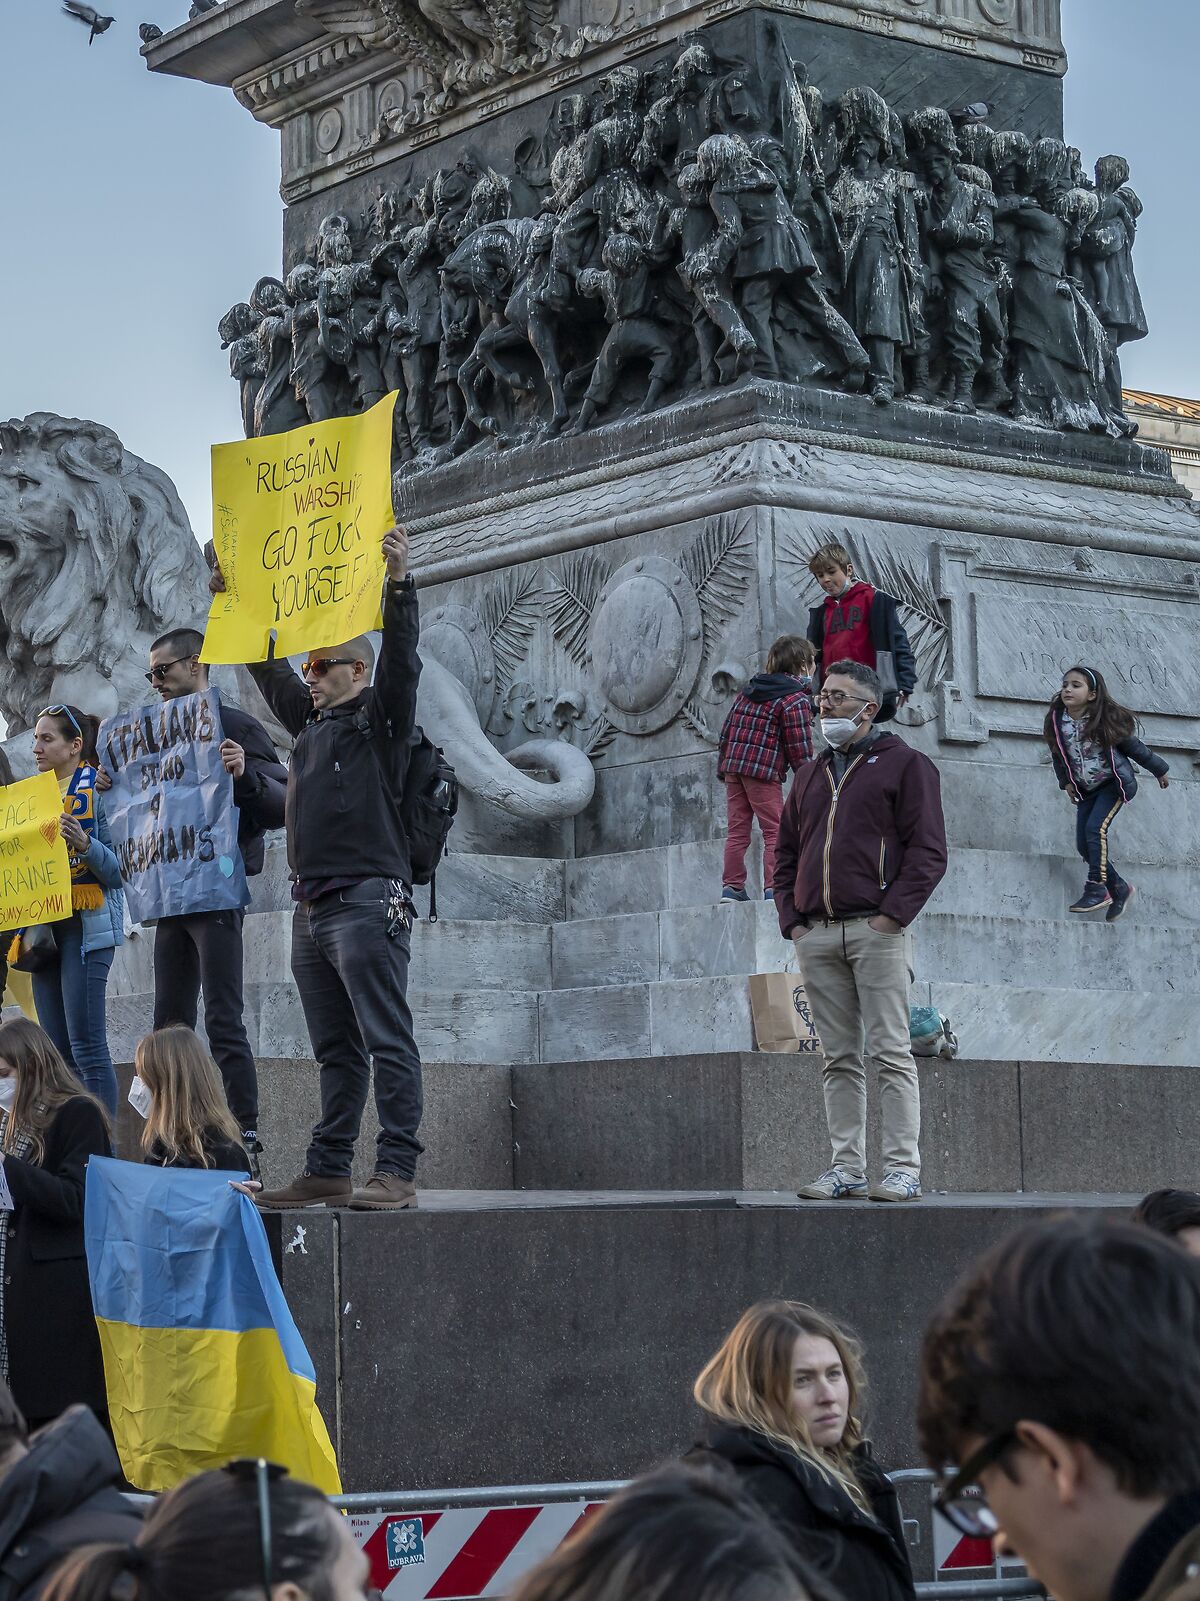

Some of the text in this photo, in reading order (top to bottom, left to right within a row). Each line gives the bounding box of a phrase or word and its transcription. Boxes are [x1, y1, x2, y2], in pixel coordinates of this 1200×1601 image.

[262, 506, 363, 570] GO FUCK
[824, 605, 863, 634] AP
[106, 699, 213, 773] ITALIANS
[0, 836, 25, 859] FOR
[799, 1038, 820, 1052] KF
[241, 1130, 257, 1138] VAN
[389, 1554, 425, 1567] DUBRAVA
